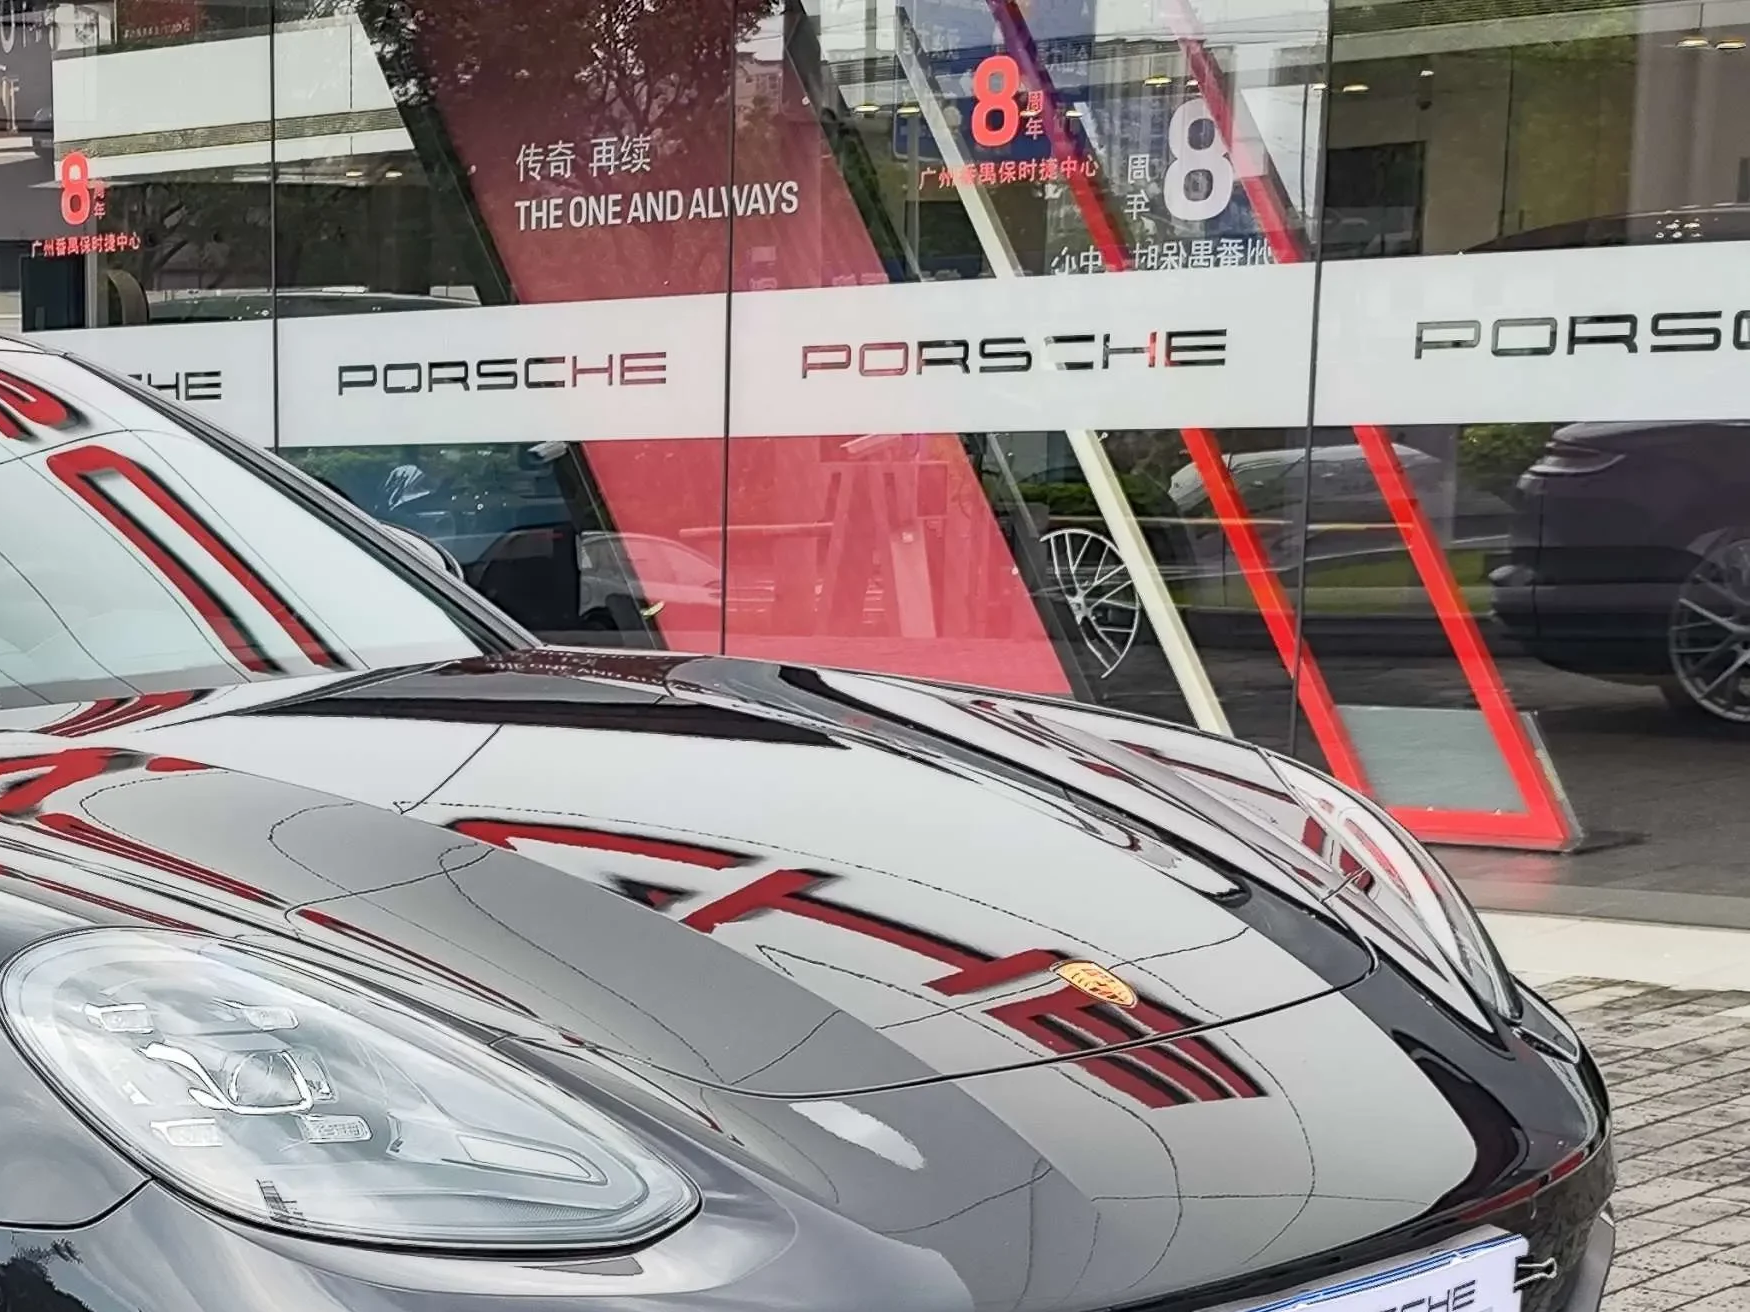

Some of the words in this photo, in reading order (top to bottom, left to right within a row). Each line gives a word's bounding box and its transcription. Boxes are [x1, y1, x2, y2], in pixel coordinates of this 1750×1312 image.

[971, 55, 1020, 147] 8
[61, 152, 90, 226] 8
[515, 139, 576, 182] 传奇
[588, 134, 652, 178] 再续
[514, 197, 563, 231] THE
[569, 193, 622, 228] ONE
[626, 189, 683, 225] AND
[688, 180, 799, 221] ALWAYS
[127, 371, 222, 401] HE
[338, 351, 667, 396] PORSCHE
[801, 327, 1228, 379] PORSCHE
[1414, 309, 1750, 360] PORS
